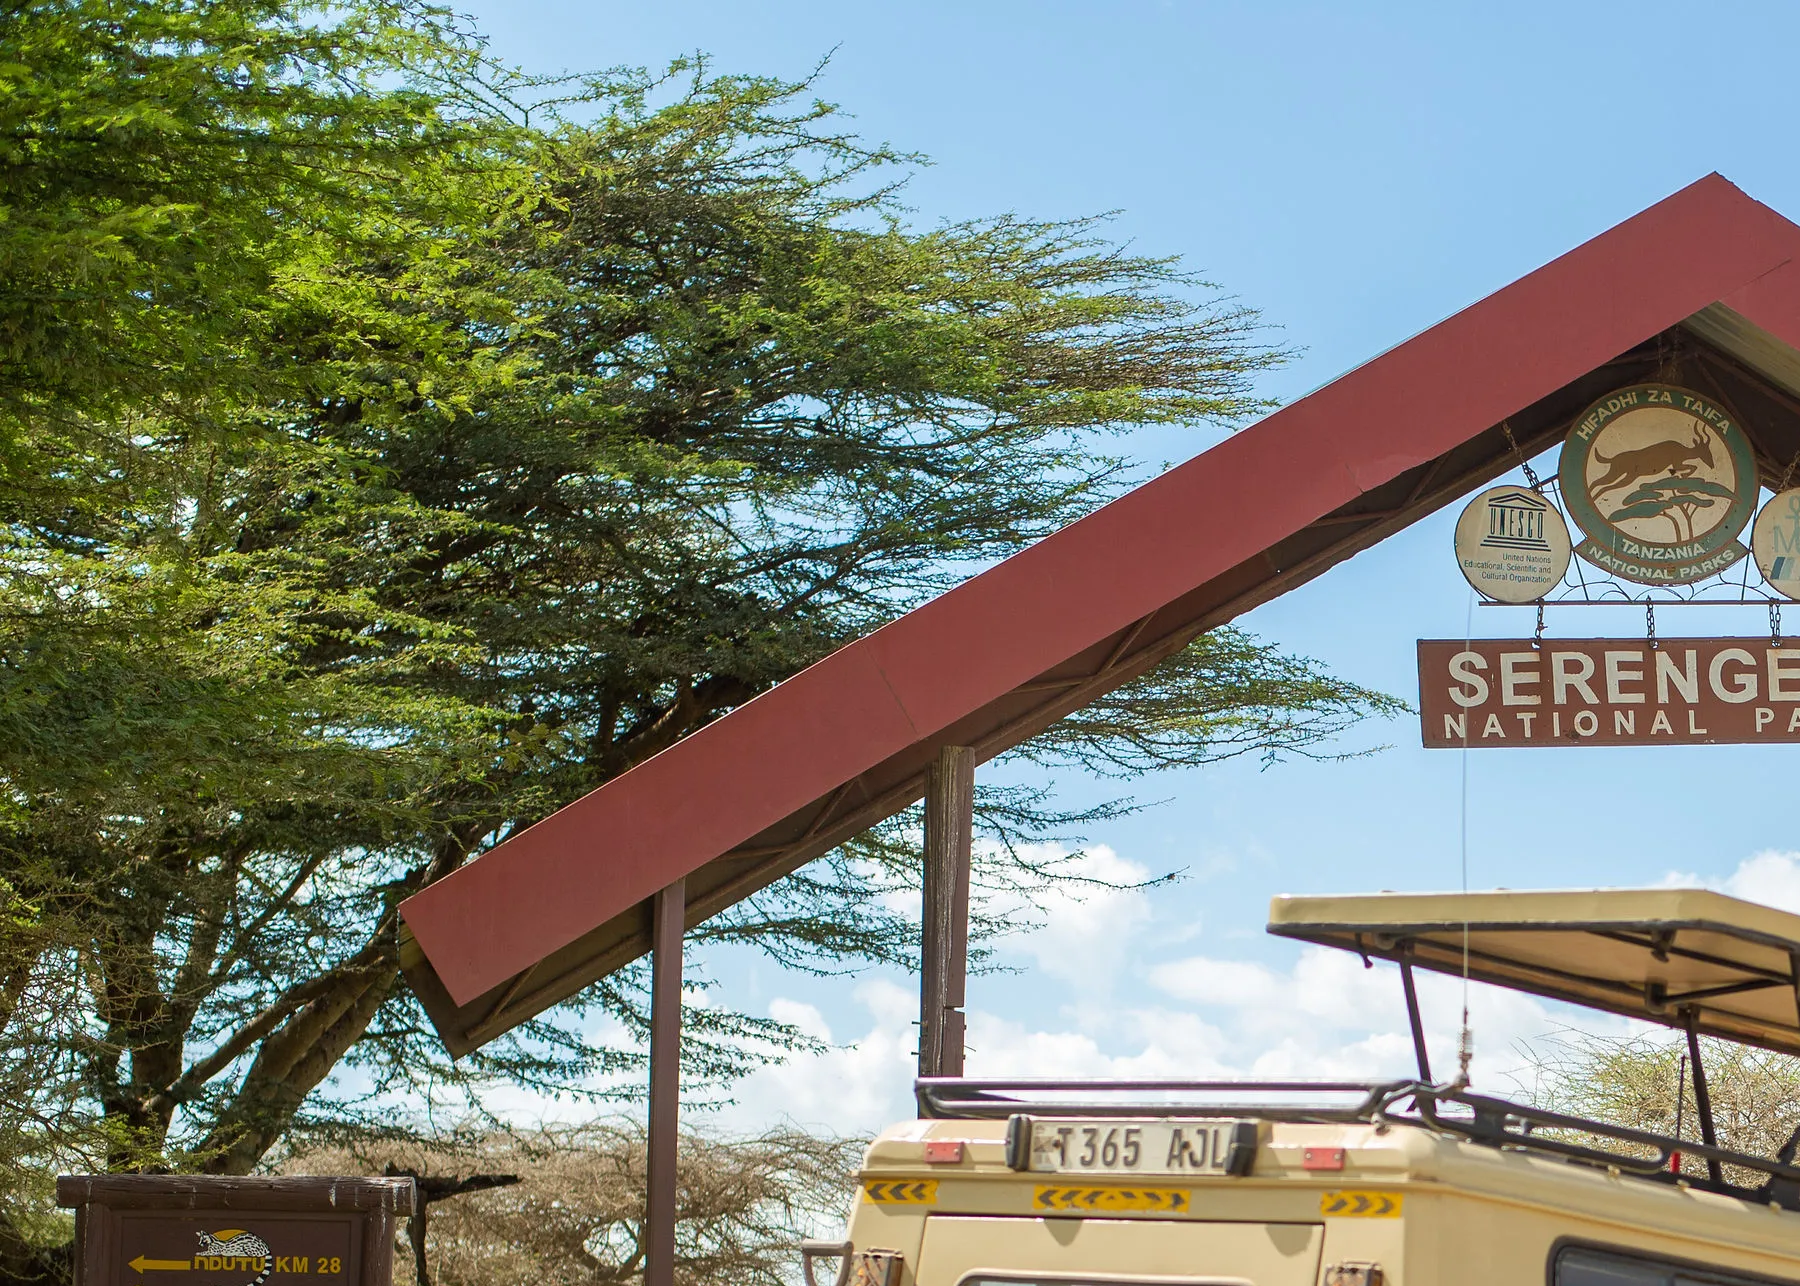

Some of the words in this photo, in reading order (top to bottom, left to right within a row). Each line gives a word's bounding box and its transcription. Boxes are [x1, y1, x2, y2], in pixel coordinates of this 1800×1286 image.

[1647, 390, 1673, 403] ZA
[1683, 395, 1731, 435] TAIFA
[1490, 507, 1544, 539] UNESCO
[1503, 552, 1525, 562] United
[1526, 555, 1552, 564] Nations
[1506, 563, 1538, 573] Scientific
[1539, 566, 1552, 574] and
[1589, 545, 1674, 579] NATIONAL
[1680, 549, 1735, 578] PARKS
[1481, 571, 1508, 581] Cultural
[1509, 573, 1552, 584] Organization
[1444, 709, 1707, 739] NATIONAL
[276, 1256, 308, 1273] KM
[317, 1257, 341, 1274] 28
